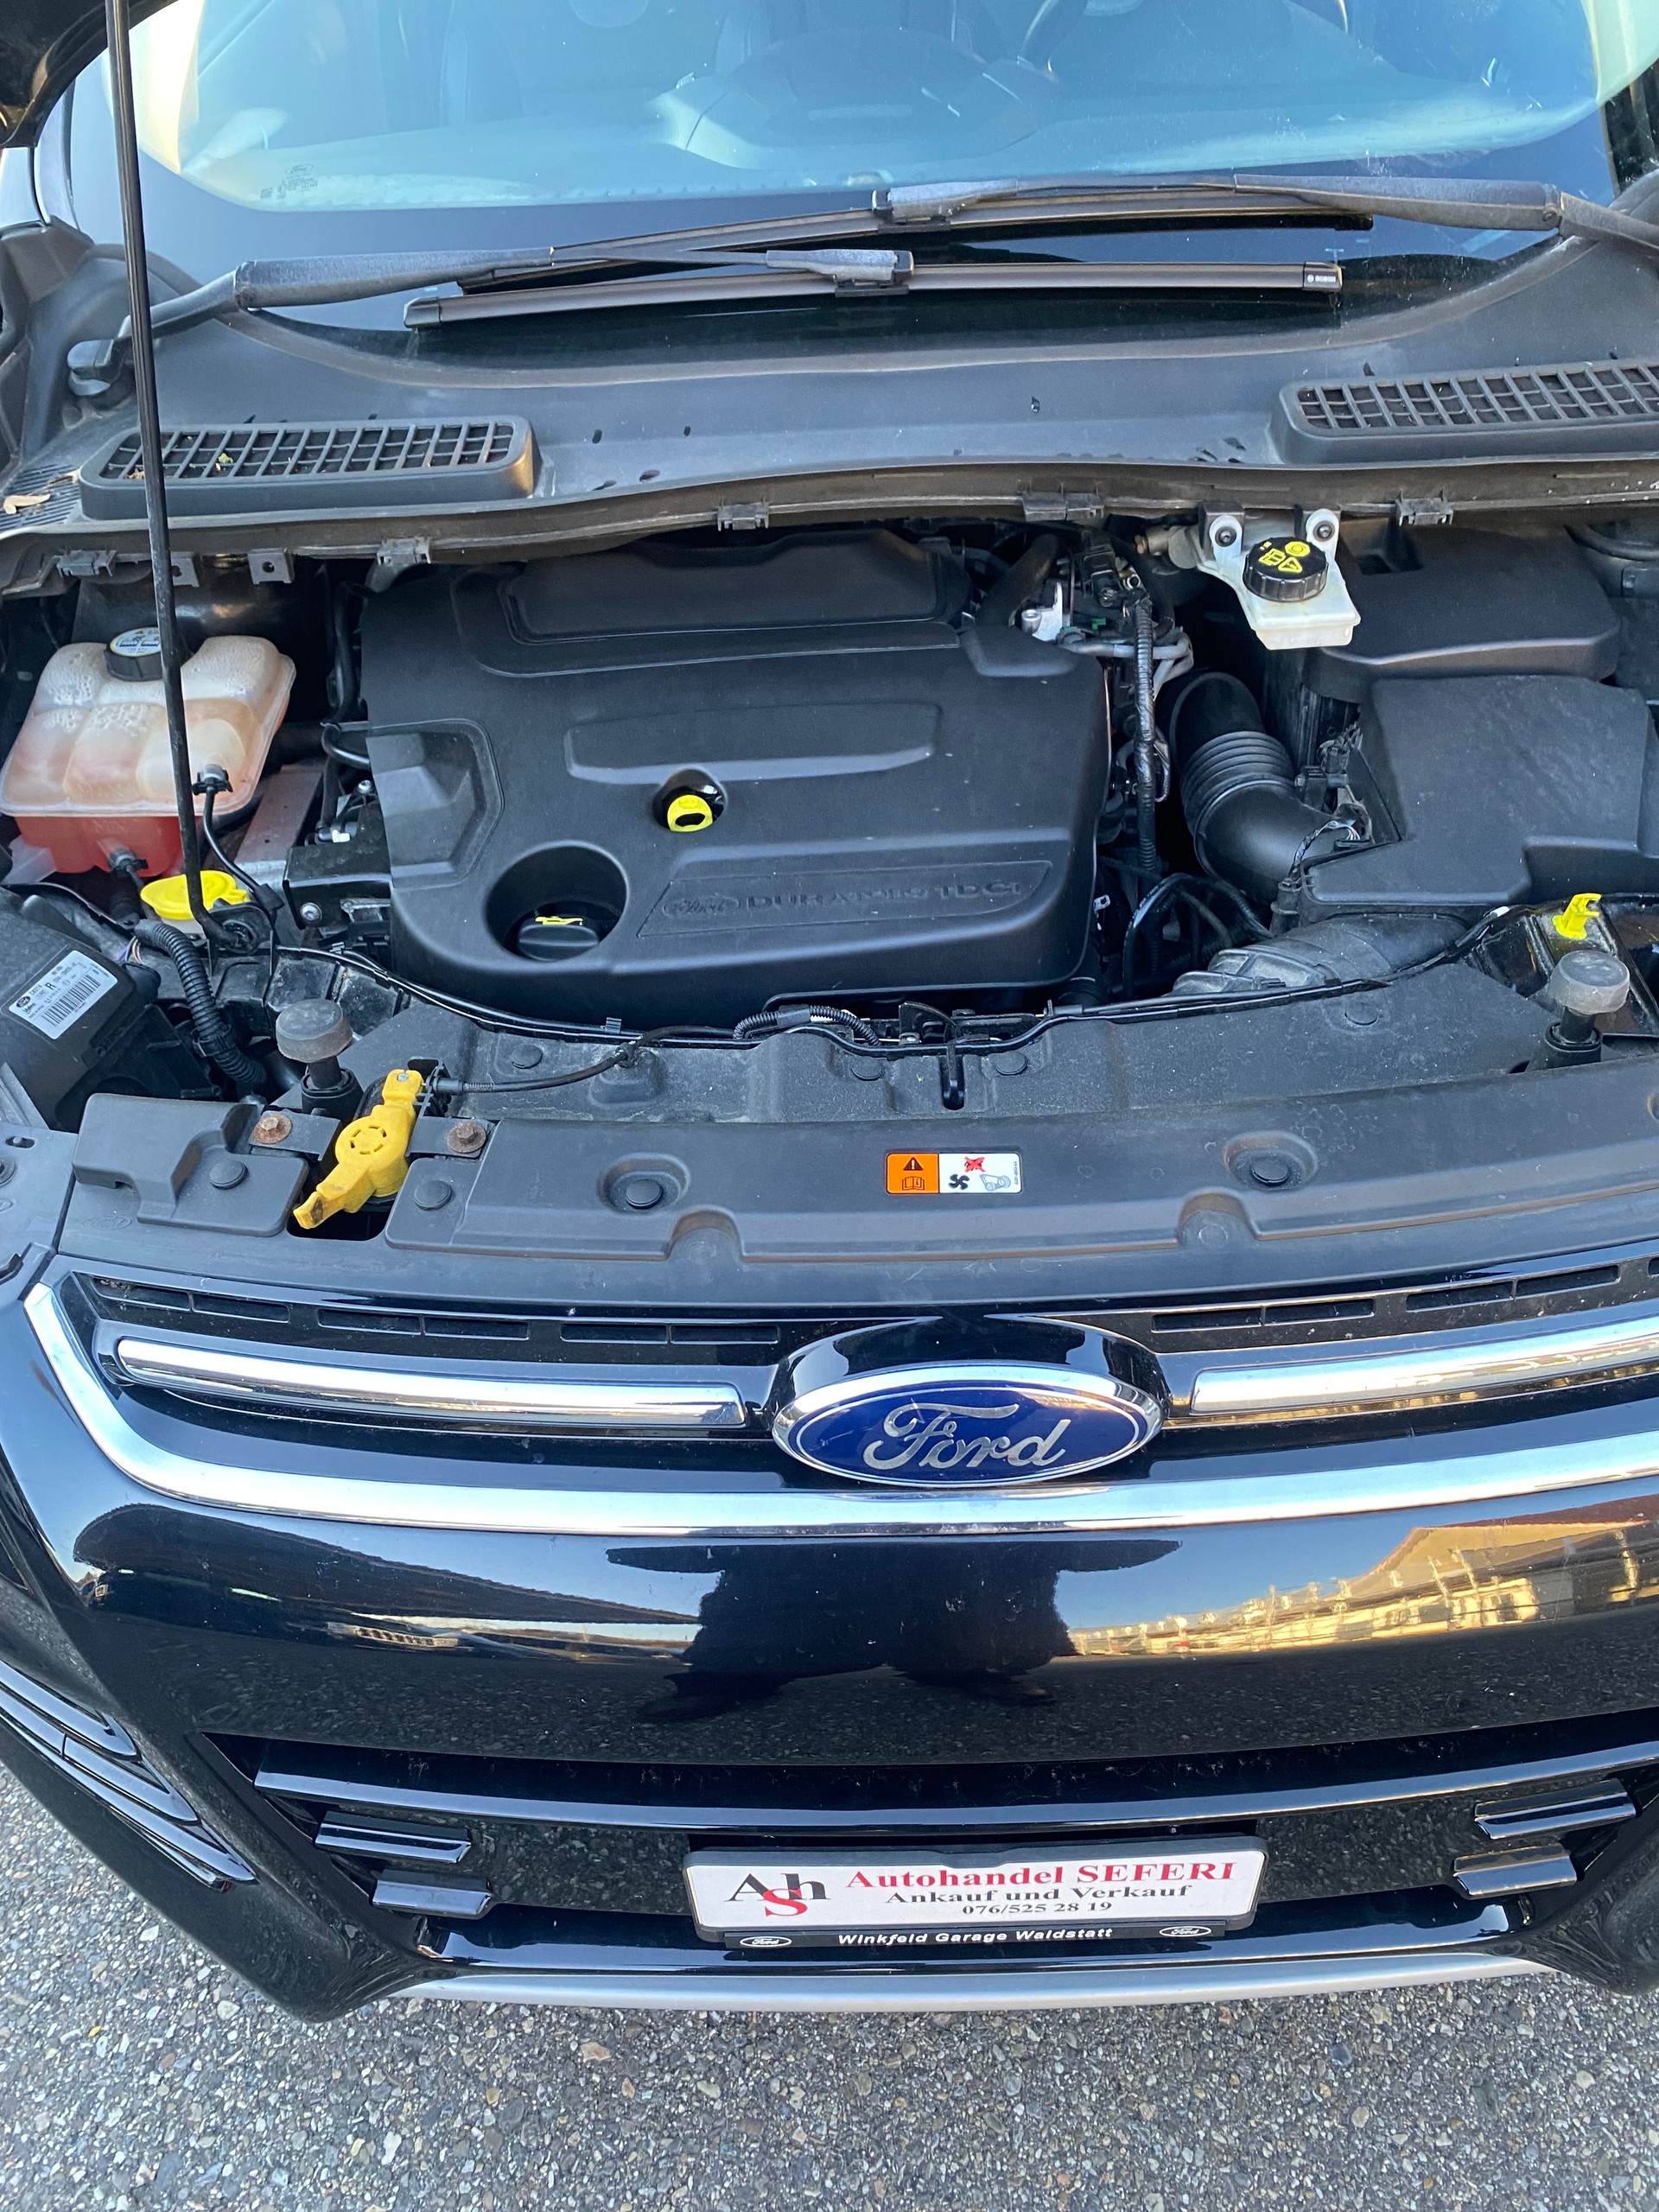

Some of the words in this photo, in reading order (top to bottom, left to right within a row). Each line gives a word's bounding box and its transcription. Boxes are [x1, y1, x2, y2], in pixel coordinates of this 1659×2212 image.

[863, 1402, 1071, 1471] Ford
[846, 1866, 1064, 1889] Autohandel
[1077, 1862, 1237, 1885] SEFERI
[885, 1890, 998, 1904] Ankauf
[1006, 1888, 1060, 1901] und
[1071, 1885, 1192, 1899] Verkauf
[963, 1903, 1046, 1915] 076/525
[1053, 1902, 1079, 1913] 28
[1087, 1901, 1112, 1912] 19
[935, 1931, 1007, 1943] Garage
[1015, 1928, 1113, 1941] Waldstatt
